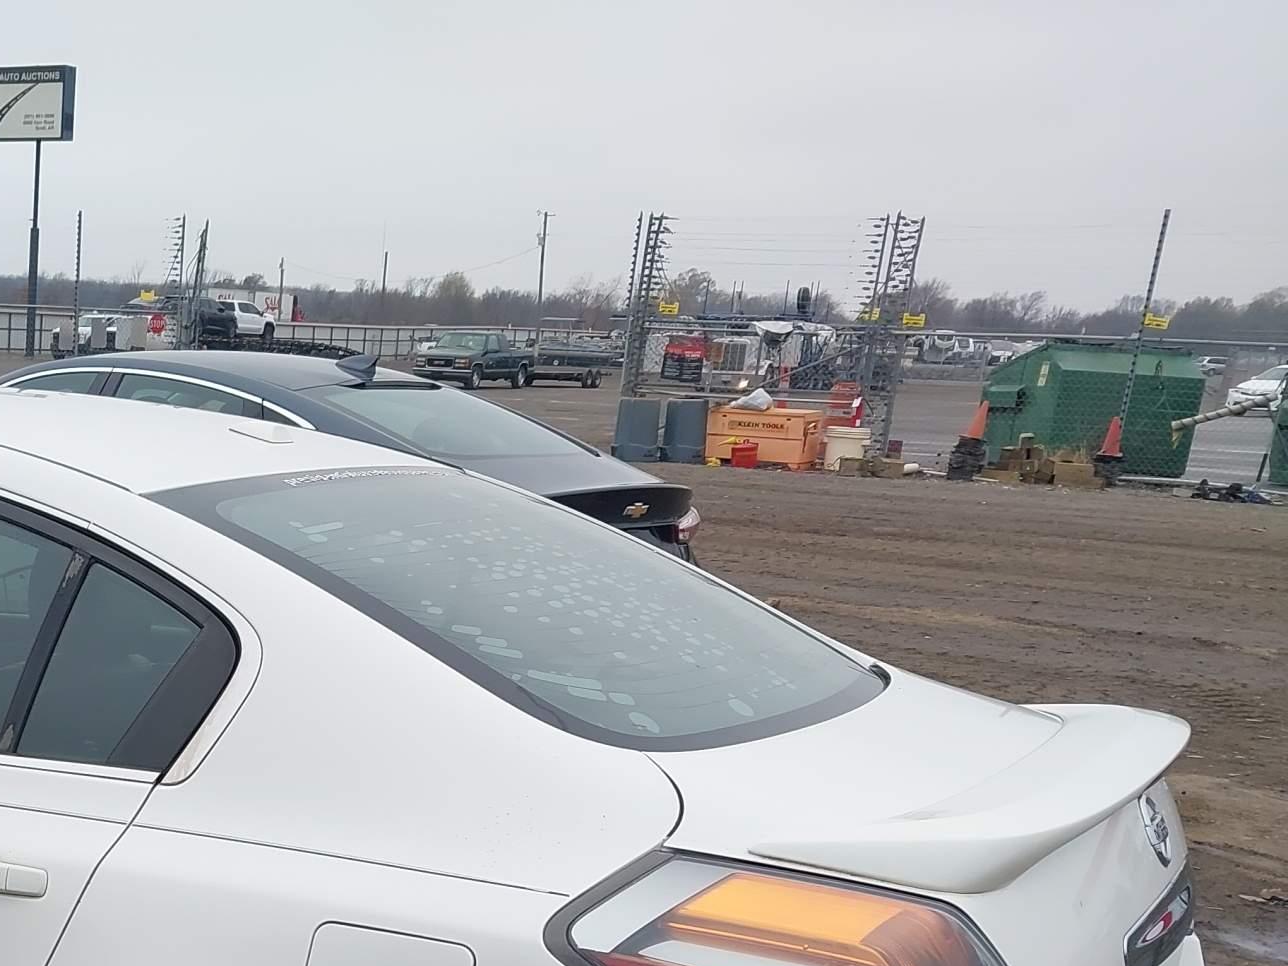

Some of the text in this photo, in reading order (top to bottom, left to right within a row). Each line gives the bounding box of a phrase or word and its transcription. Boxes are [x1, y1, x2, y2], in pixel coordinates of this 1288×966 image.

[0, 72, 19, 82] AUTO
[21, 71, 60, 81] AUCTIONS
[150, 319, 165, 328] STOP
